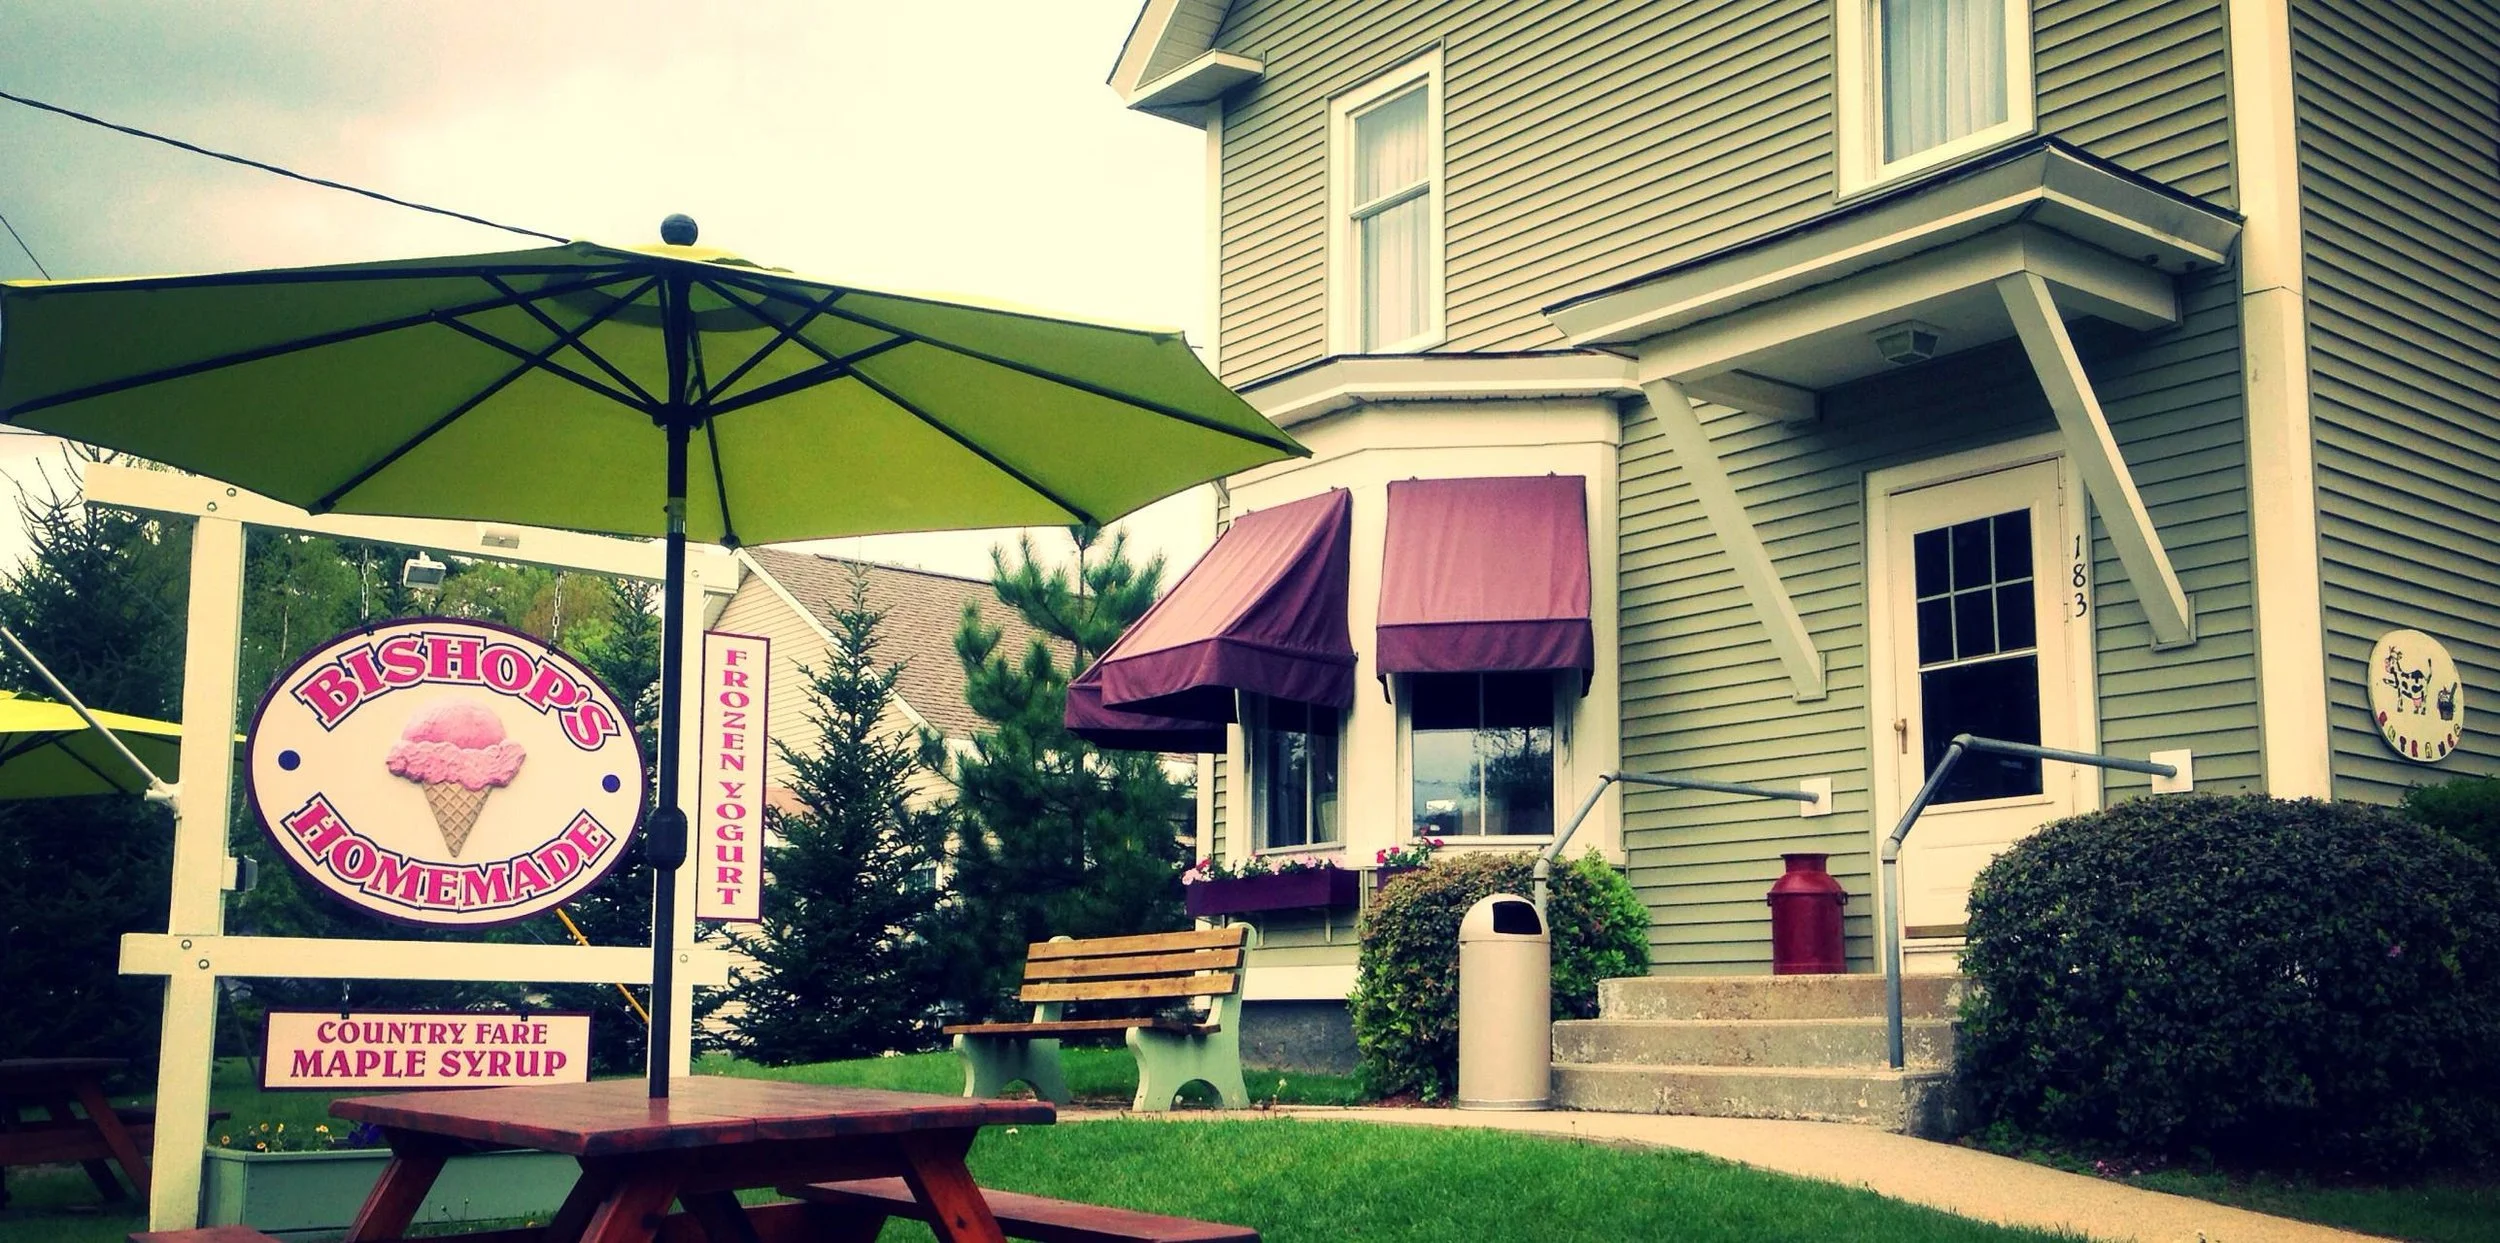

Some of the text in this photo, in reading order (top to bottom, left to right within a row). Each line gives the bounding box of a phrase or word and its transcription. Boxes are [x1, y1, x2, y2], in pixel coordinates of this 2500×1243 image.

[2072, 534, 2088, 618] 183
[293, 633, 618, 749] BISHOP'S
[716, 649, 750, 905] FROZEN YOGURT
[283, 794, 614, 912] HOMEMADE
[290, 1049, 567, 1078] MAPLE SYRUP
[317, 1021, 548, 1045] COUNTRY FARE
